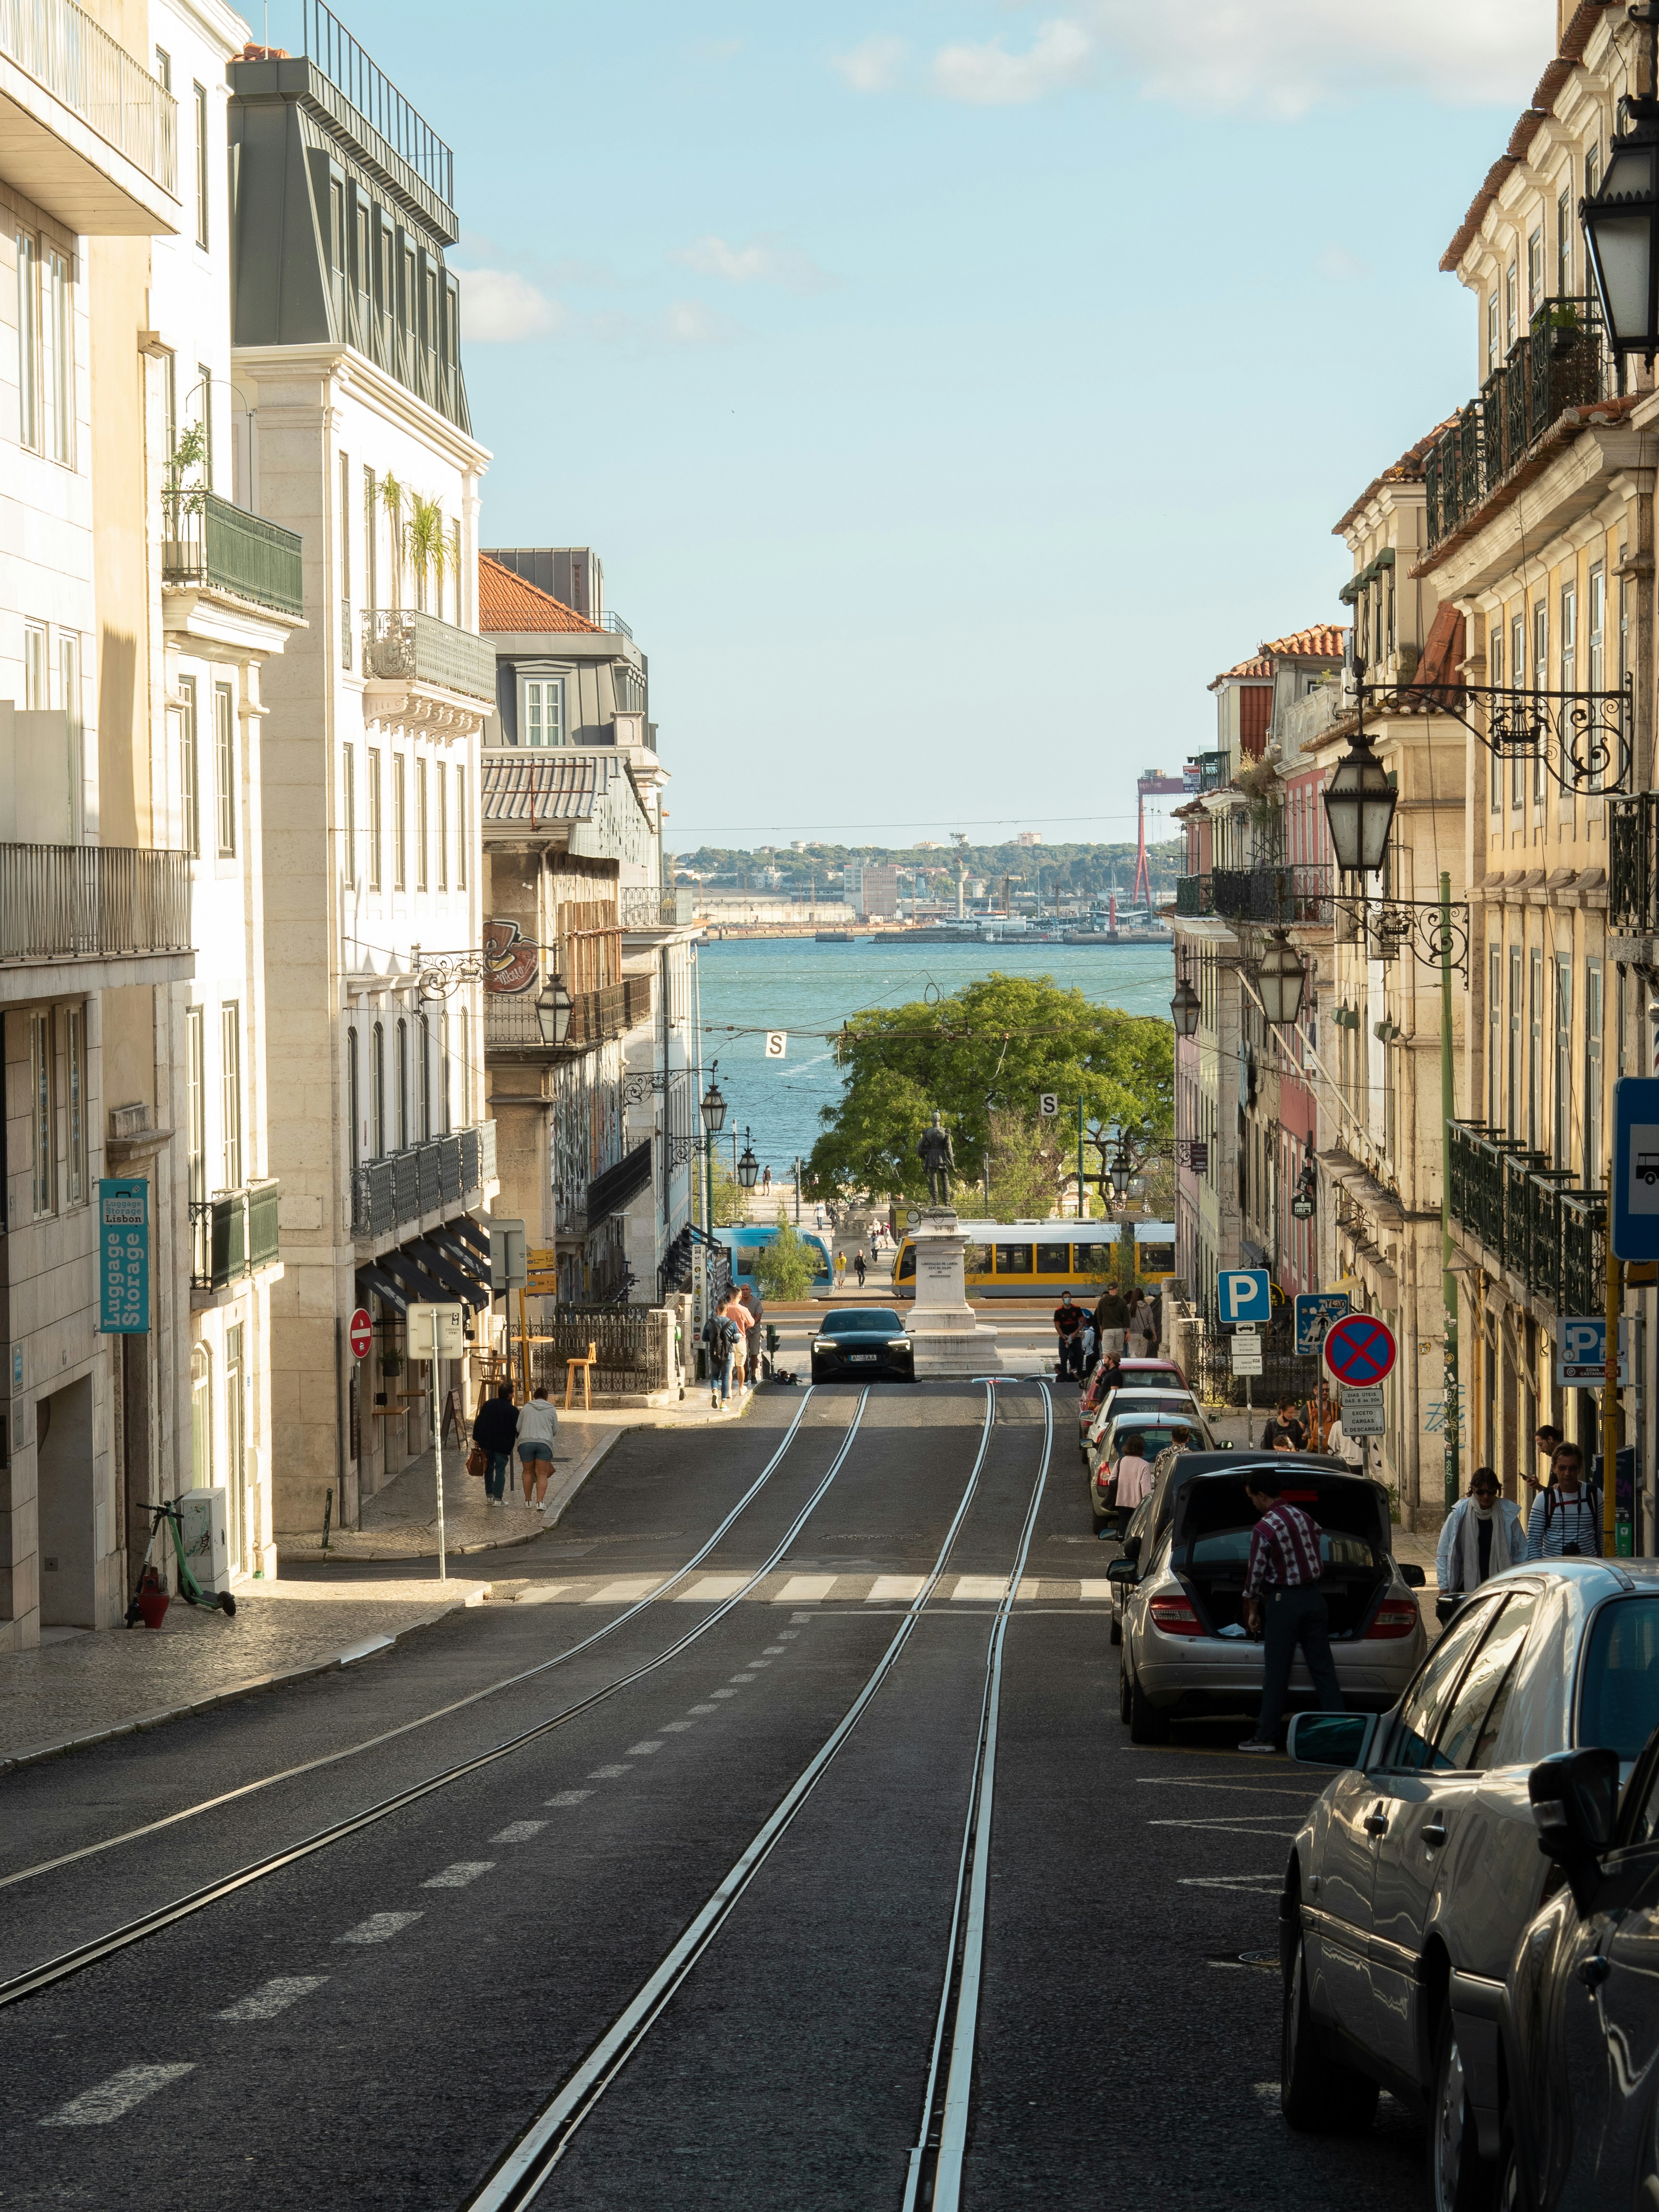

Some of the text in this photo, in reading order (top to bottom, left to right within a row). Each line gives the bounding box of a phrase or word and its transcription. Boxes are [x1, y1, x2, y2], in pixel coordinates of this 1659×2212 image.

[769, 1035, 782, 1054] S
[1043, 1096, 1055, 1113] S
[106, 1207, 142, 1216] Storage
[106, 1214, 142, 1223] Lisbon
[104, 1233, 124, 1327] Luggage
[121, 1233, 144, 1326] Storage
[1228, 1275, 1258, 1317] P
[1572, 1326, 1599, 1362] P
